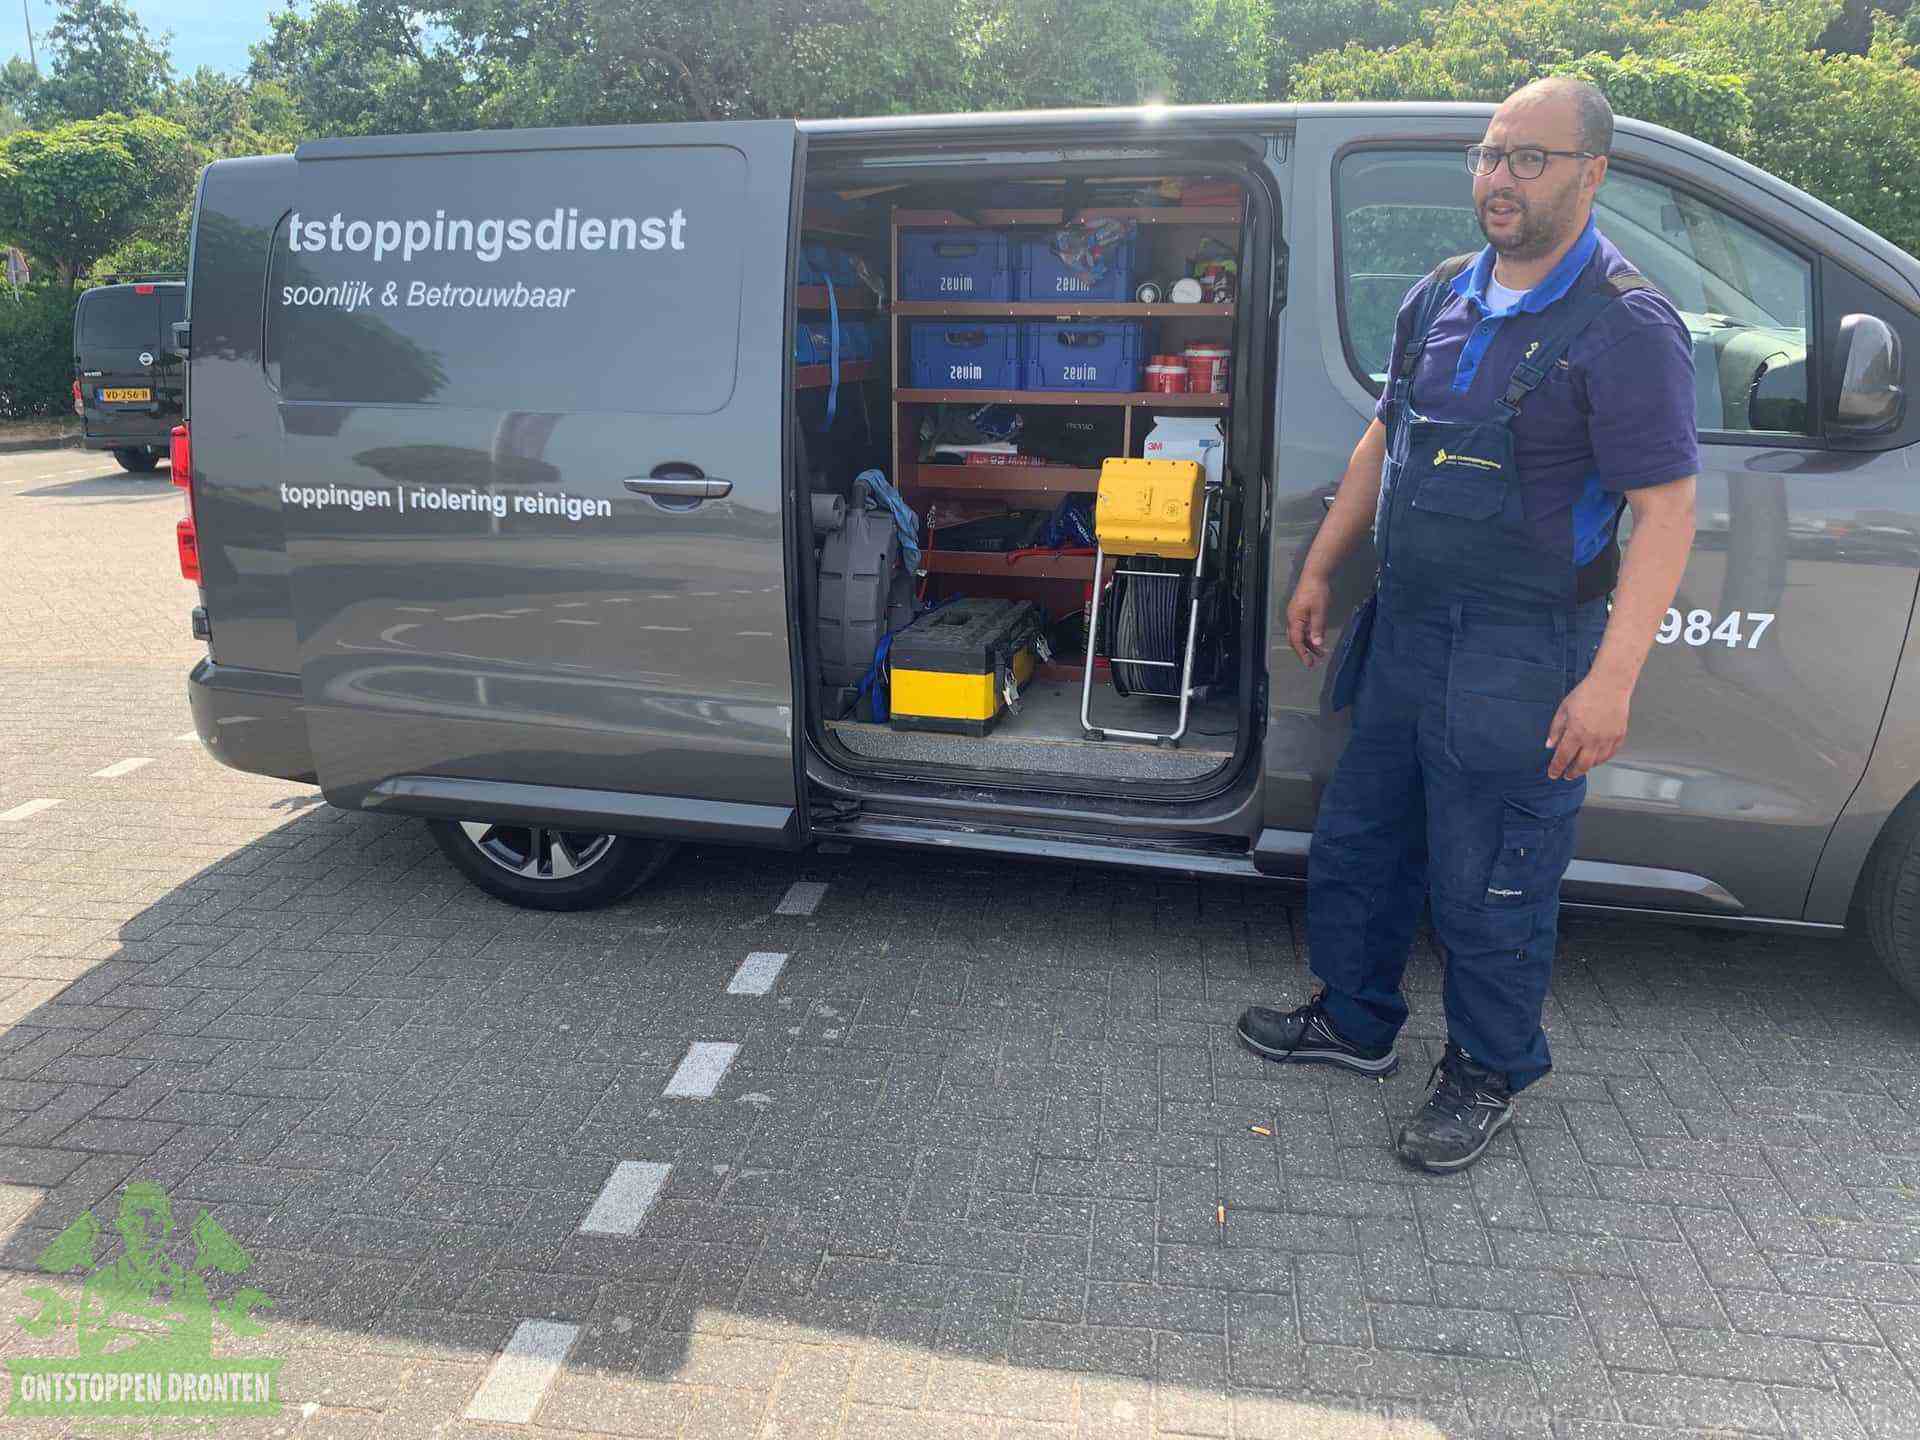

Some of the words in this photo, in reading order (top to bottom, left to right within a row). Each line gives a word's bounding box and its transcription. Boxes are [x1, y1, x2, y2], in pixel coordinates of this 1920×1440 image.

[288, 207, 687, 262] tstoppingsdienst
[281, 280, 374, 312] soonlijk
[381, 280, 399, 307] &
[406, 281, 575, 308] Betrouwbaar
[280, 483, 391, 512] toppingen
[410, 487, 506, 517] riolering
[514, 493, 612, 521] reinigen
[1655, 607, 1776, 649] 9847
